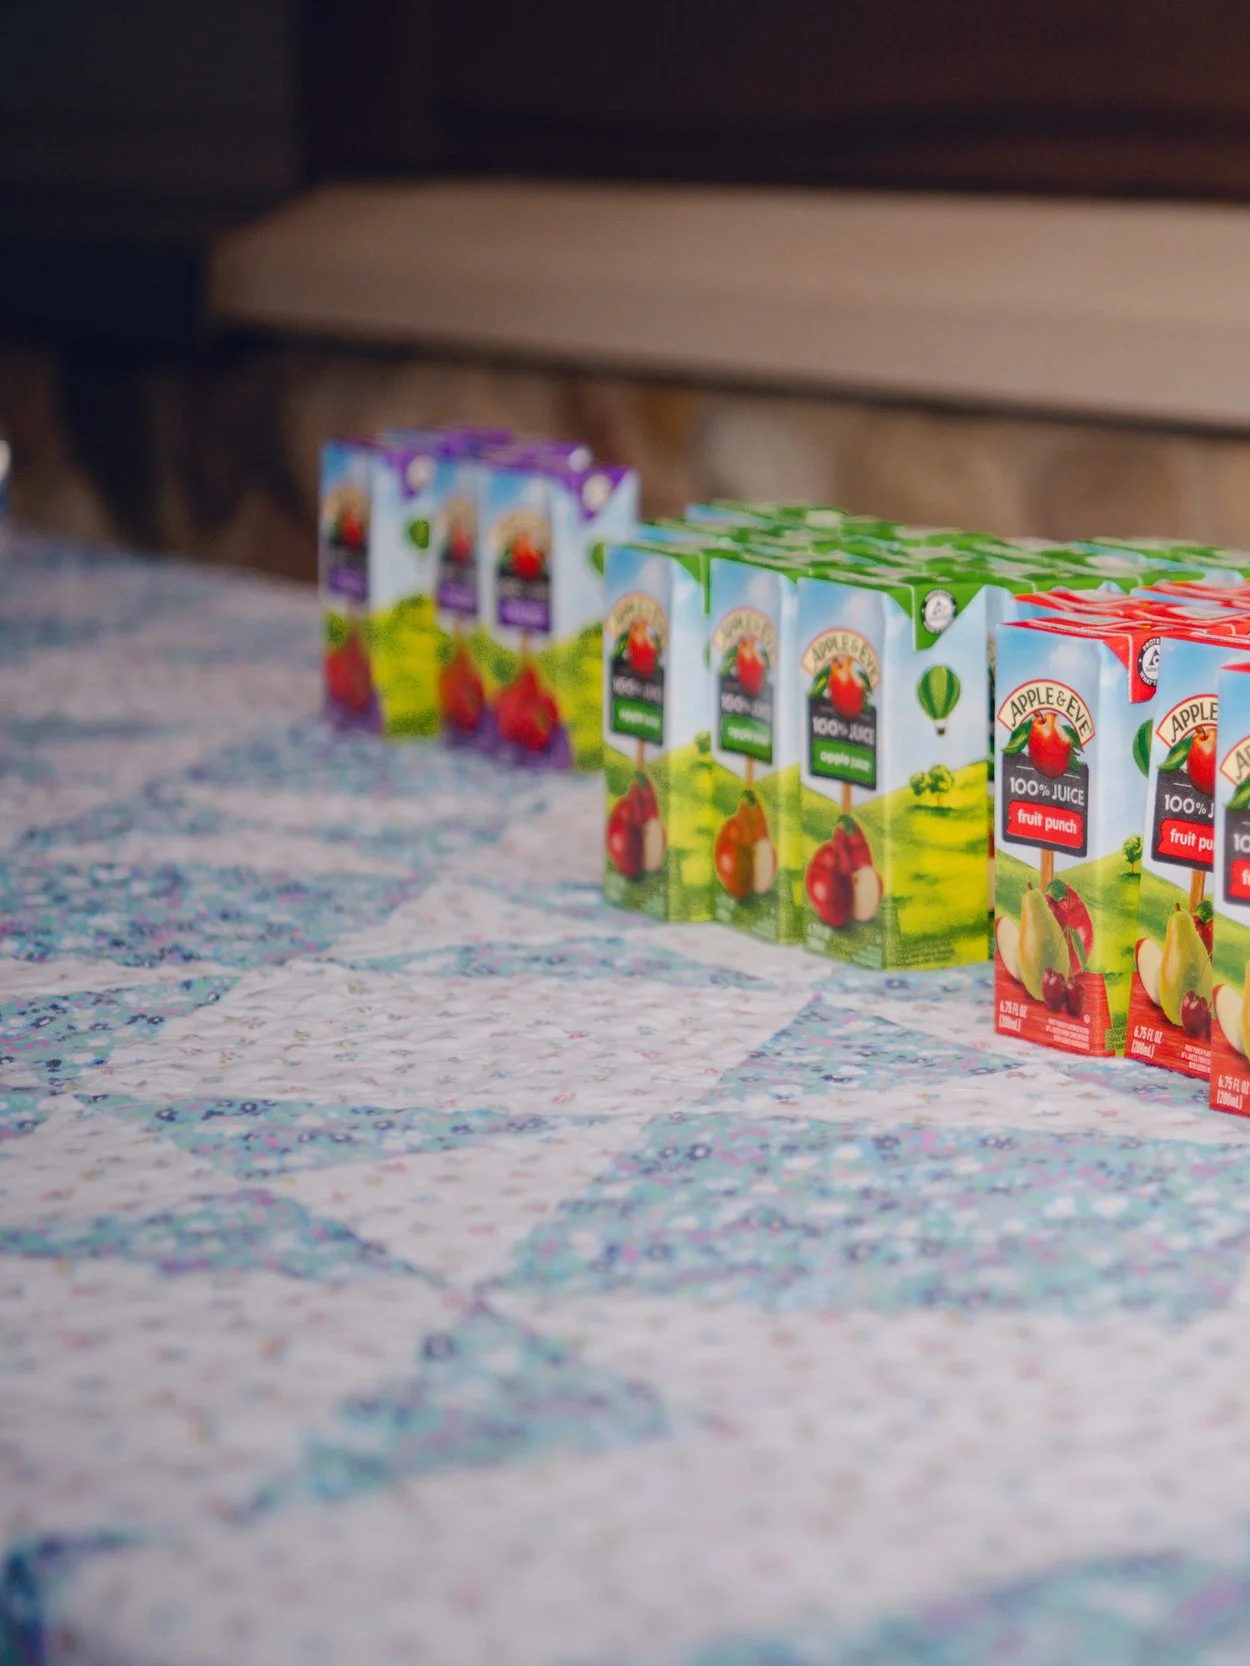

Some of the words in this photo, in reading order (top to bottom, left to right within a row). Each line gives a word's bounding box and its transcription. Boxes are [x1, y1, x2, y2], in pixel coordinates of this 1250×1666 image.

[1010, 686, 1054, 728] APPLE
[1056, 690, 1066, 707] &
[1066, 694, 1090, 737] EVE
[1171, 702, 1218, 743] APPLE
[812, 716, 848, 737] 100%
[849, 722, 875, 744] JUICE
[1010, 777, 1050, 797] 100%
[1052, 783, 1085, 806] JUICE
[1164, 794, 1206, 815] 100%
[1017, 809, 1042, 827] fruit
[1045, 816, 1076, 835] punch
[1170, 828, 1197, 847] fruit
[1134, 1025, 1147, 1040] 6.75
[1217, 1075, 1233, 1090] 6.75
[1233, 1077, 1240, 1092] FL
[1241, 1080, 1250, 1095] OZ
